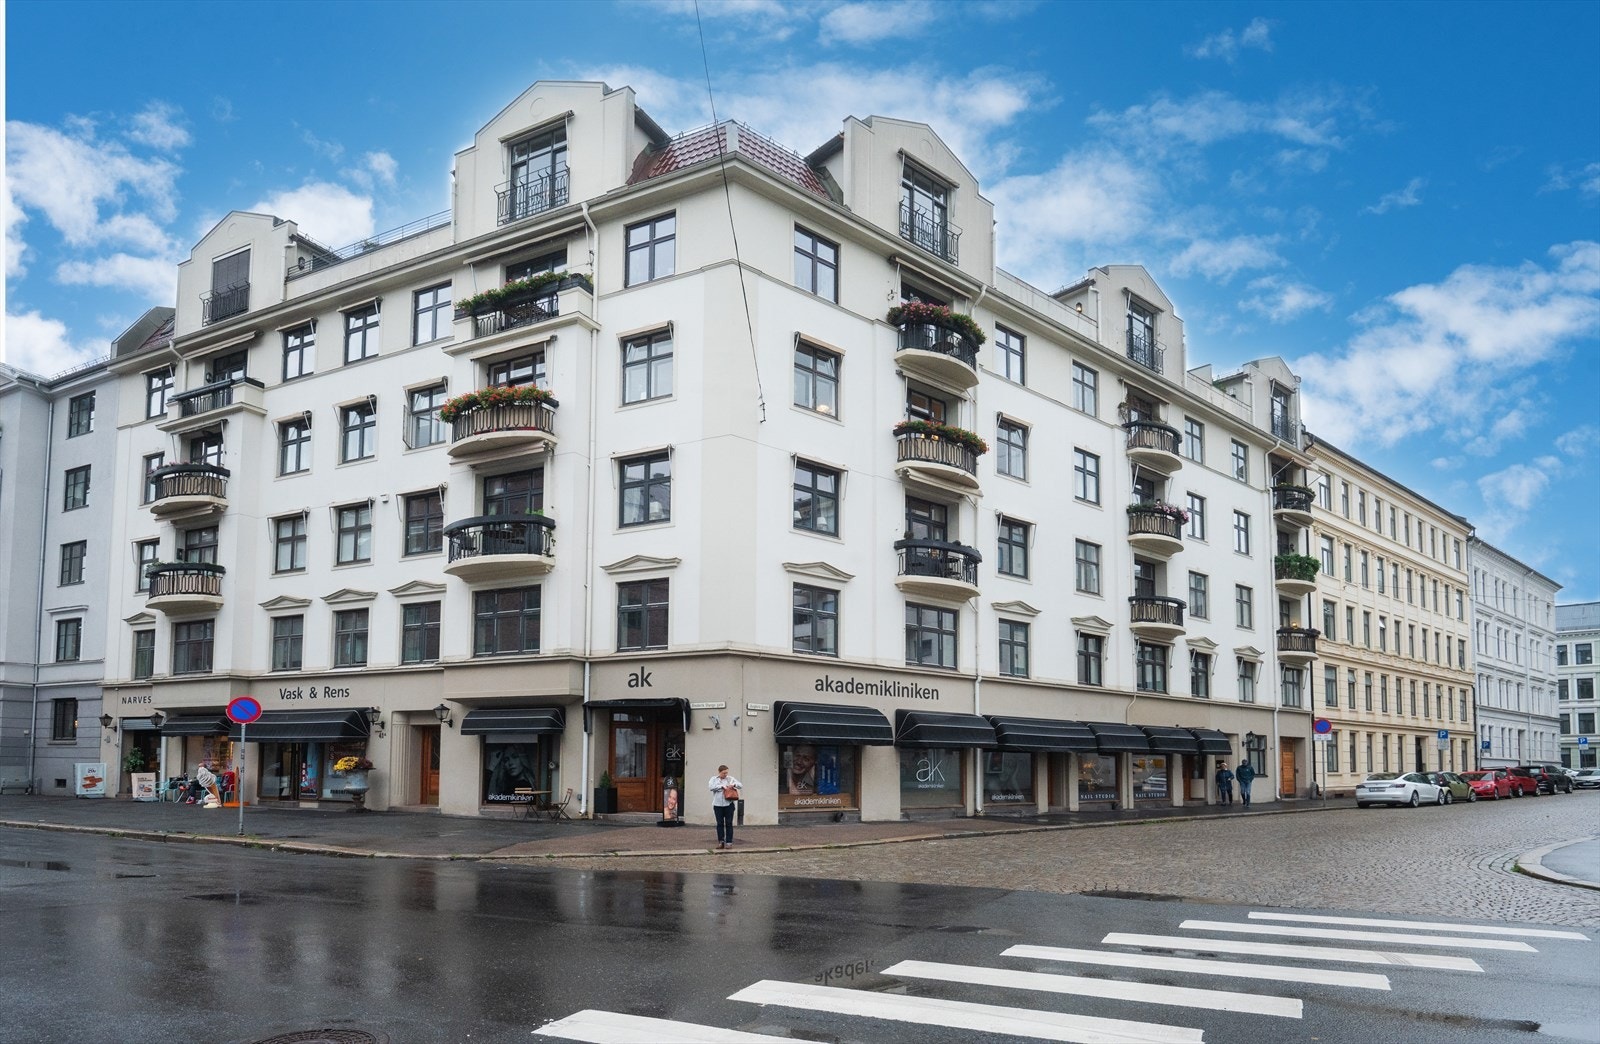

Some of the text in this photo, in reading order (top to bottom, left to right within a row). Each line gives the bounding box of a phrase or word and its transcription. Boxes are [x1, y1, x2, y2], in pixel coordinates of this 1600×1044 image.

[627, 666, 653, 688] ak
[815, 675, 939, 700] akademikliniken
[121, 696, 152, 704] NARVES
[279, 686, 350, 700] Vask & Rens
[916, 752, 945, 782] ak
